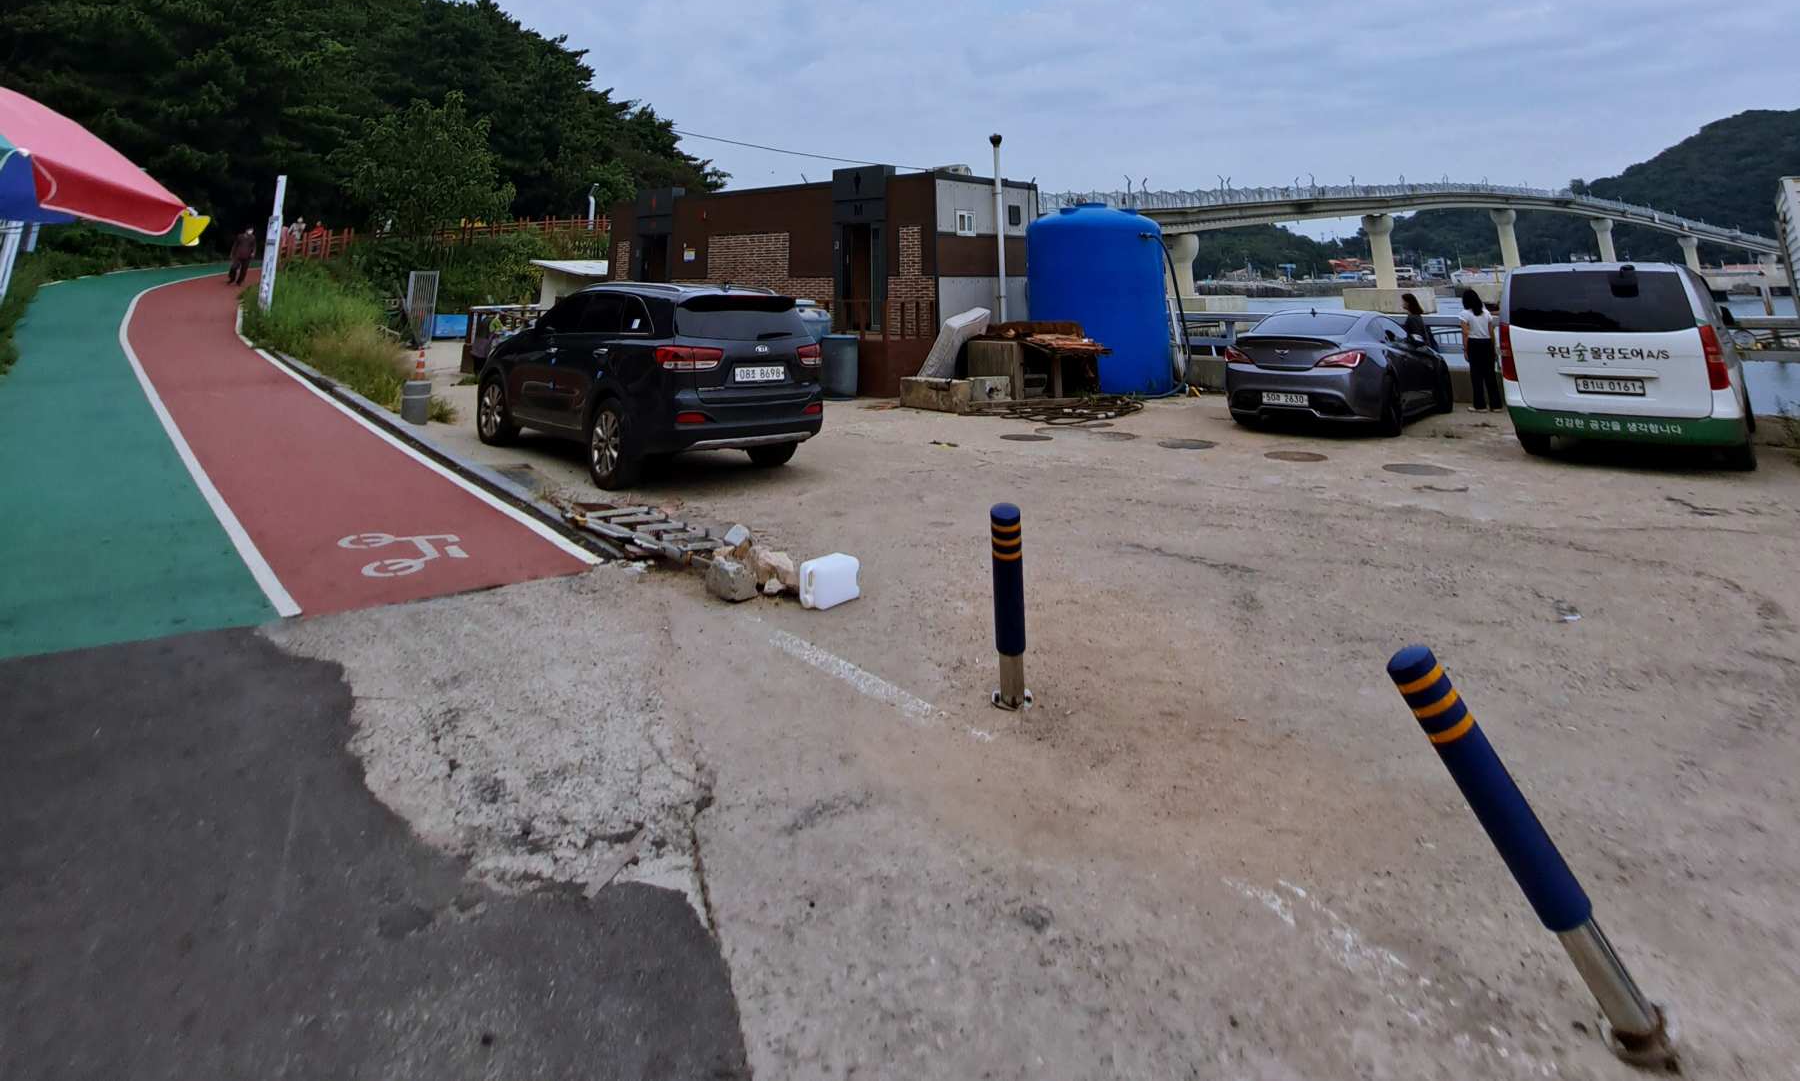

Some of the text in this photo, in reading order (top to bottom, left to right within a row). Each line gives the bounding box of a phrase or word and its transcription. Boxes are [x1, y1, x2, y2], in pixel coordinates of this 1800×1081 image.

[760, 367, 781, 379] 8698
[1608, 381, 1637, 392] 0161
[1554, 417, 1584, 429] 건강한
[1627, 422, 1682, 435] 생각합니다
